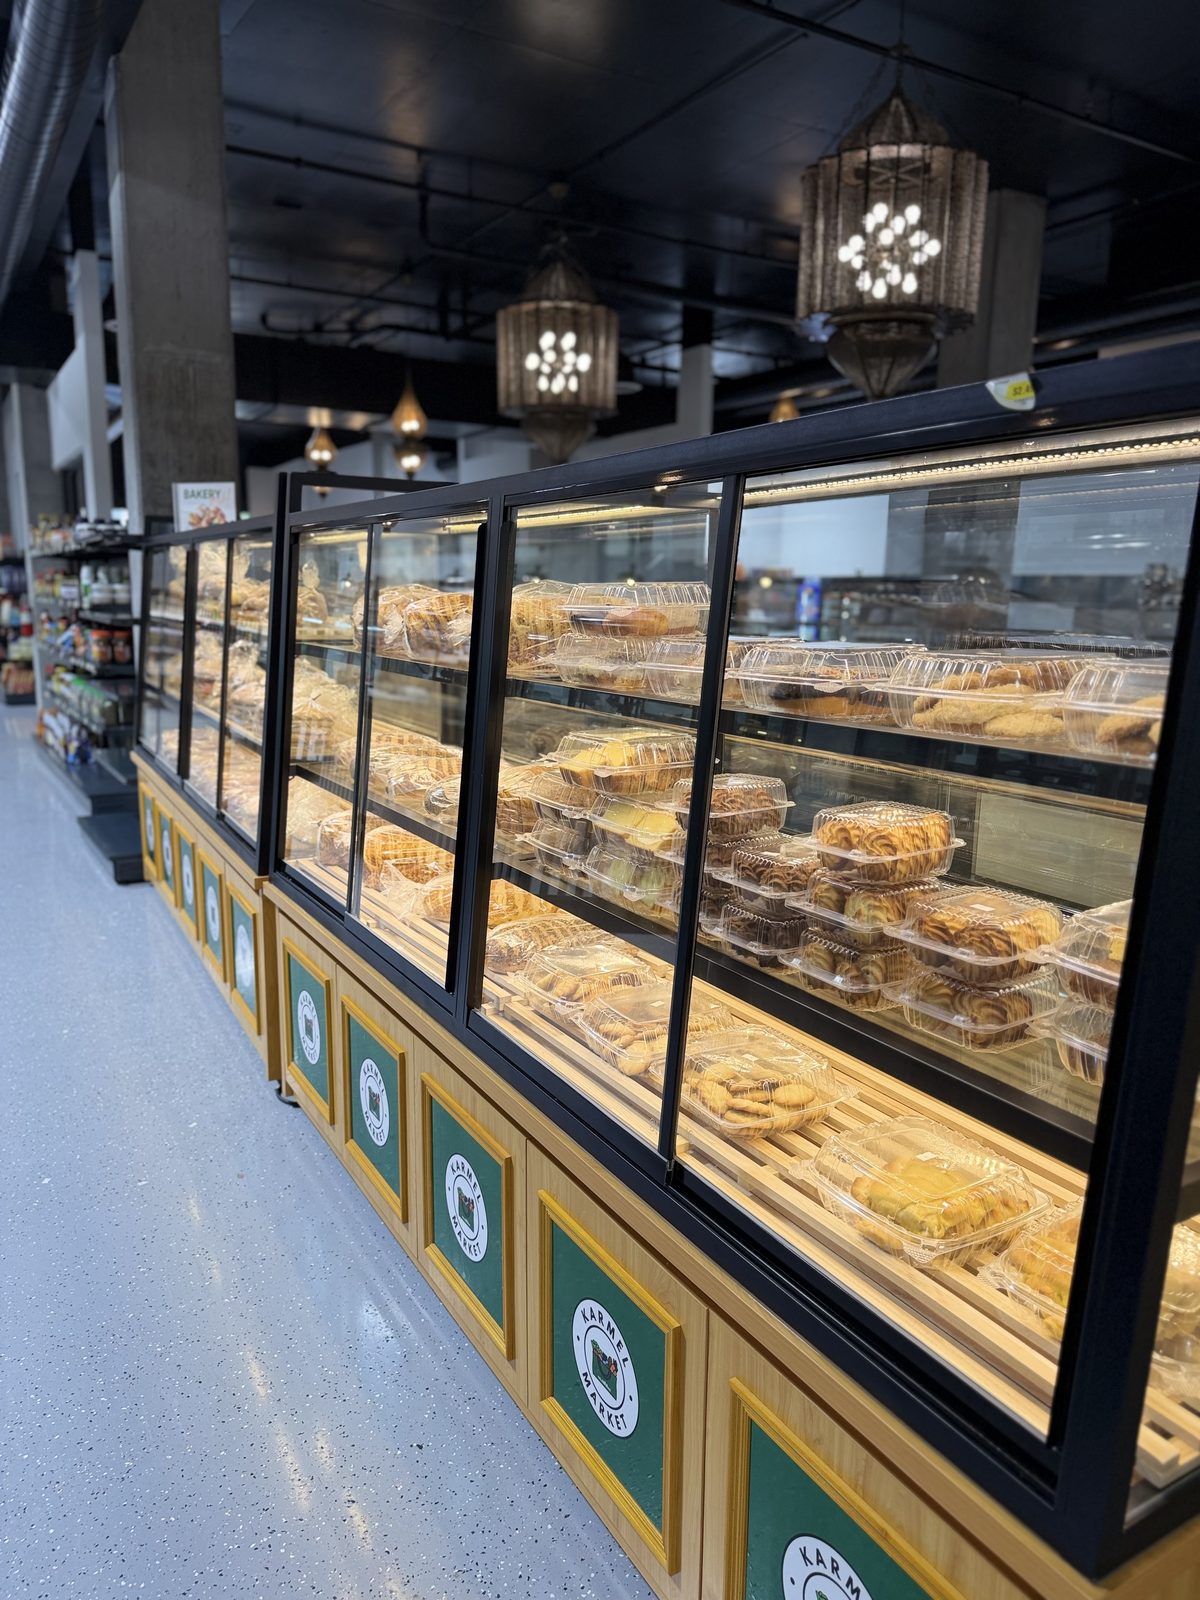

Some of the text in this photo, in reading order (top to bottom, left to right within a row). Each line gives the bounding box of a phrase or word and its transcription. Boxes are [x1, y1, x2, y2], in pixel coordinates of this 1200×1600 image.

[183, 488, 221, 500] BAKERY
[363, 1063, 385, 1094] KARMEL
[364, 1110, 386, 1142] MARKET
[450, 1159, 481, 1204] KARMEL
[452, 1215, 481, 1257] MARKET
[580, 1306, 629, 1368] KARMEL
[582, 1371, 628, 1430] MARKET
[798, 1545, 861, 1600] KARM
